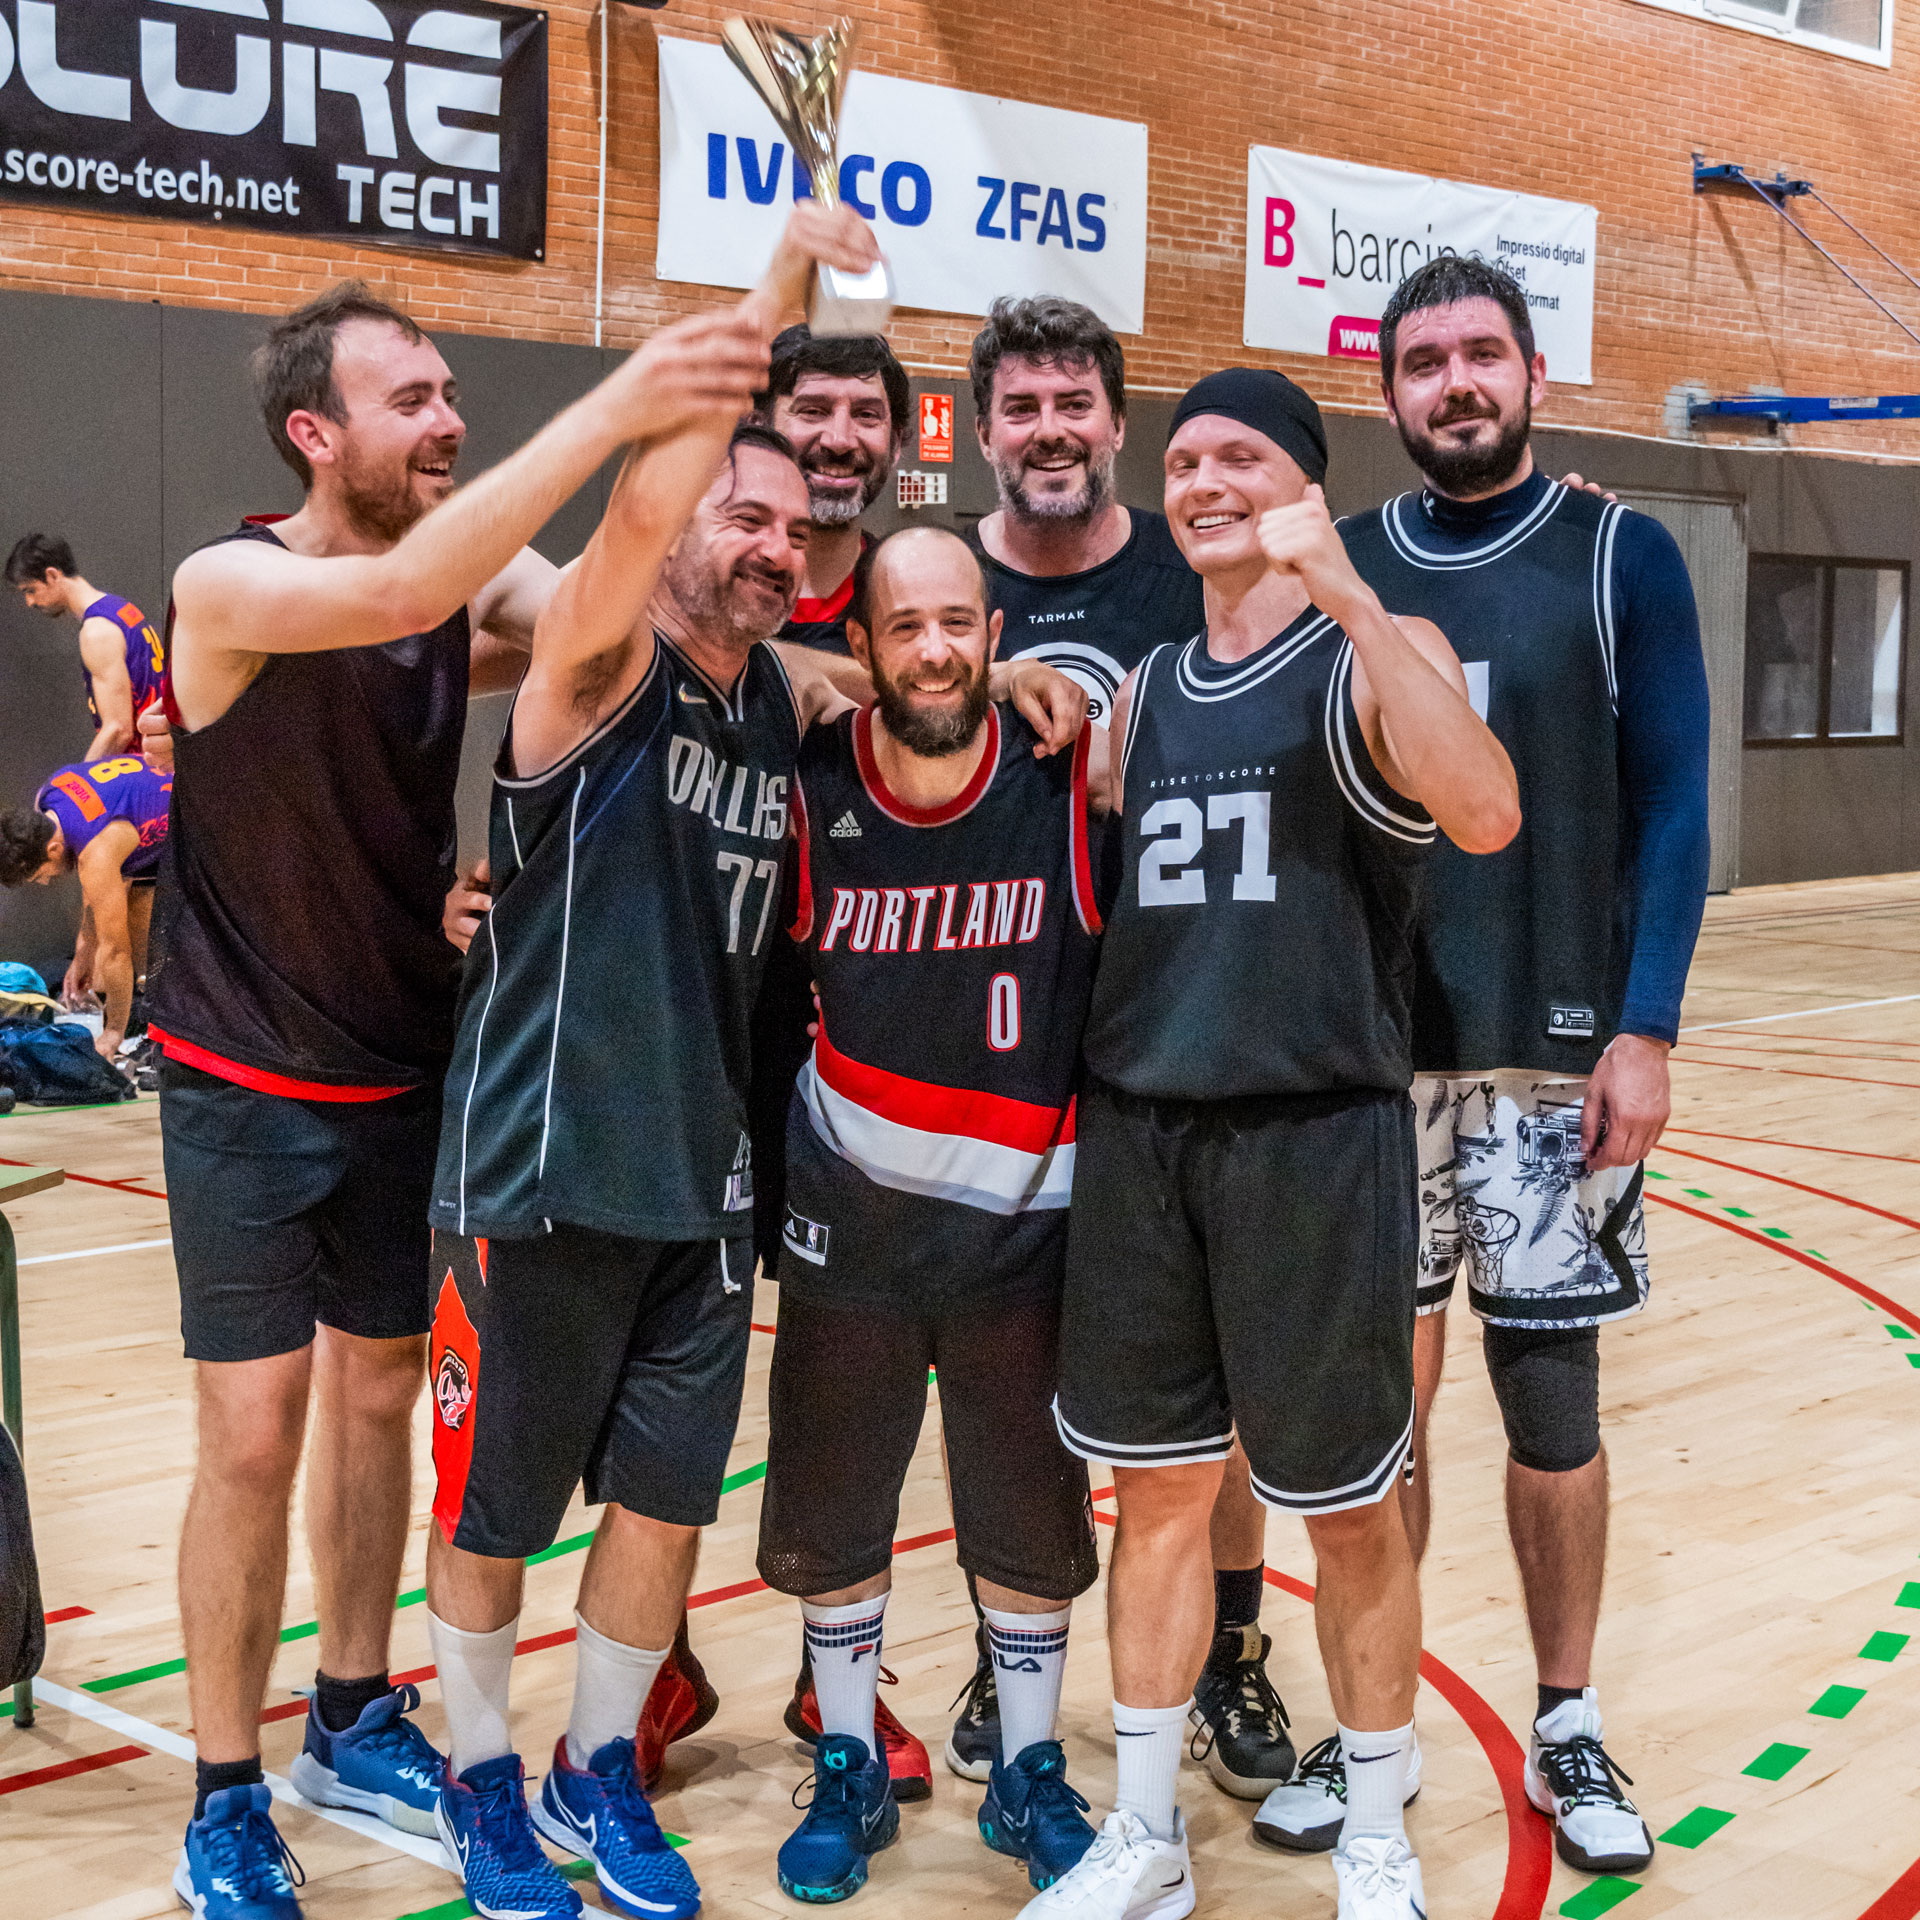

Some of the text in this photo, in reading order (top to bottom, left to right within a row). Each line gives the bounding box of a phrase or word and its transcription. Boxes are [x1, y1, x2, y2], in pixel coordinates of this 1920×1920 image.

[0, 0, 502, 173] CORE
[336, 163, 500, 239] TECH
[976, 176, 1106, 253] ZFAS
[1331, 208, 1457, 284] barci
[1496, 234, 1585, 266] Impressió digital
[1028, 610, 1085, 624] TARMAK
[829, 827, 862, 838] adidas
[717, 850, 778, 956] 77
[818, 877, 1046, 953] PORTLAND
[986, 971, 1022, 1052] 0
